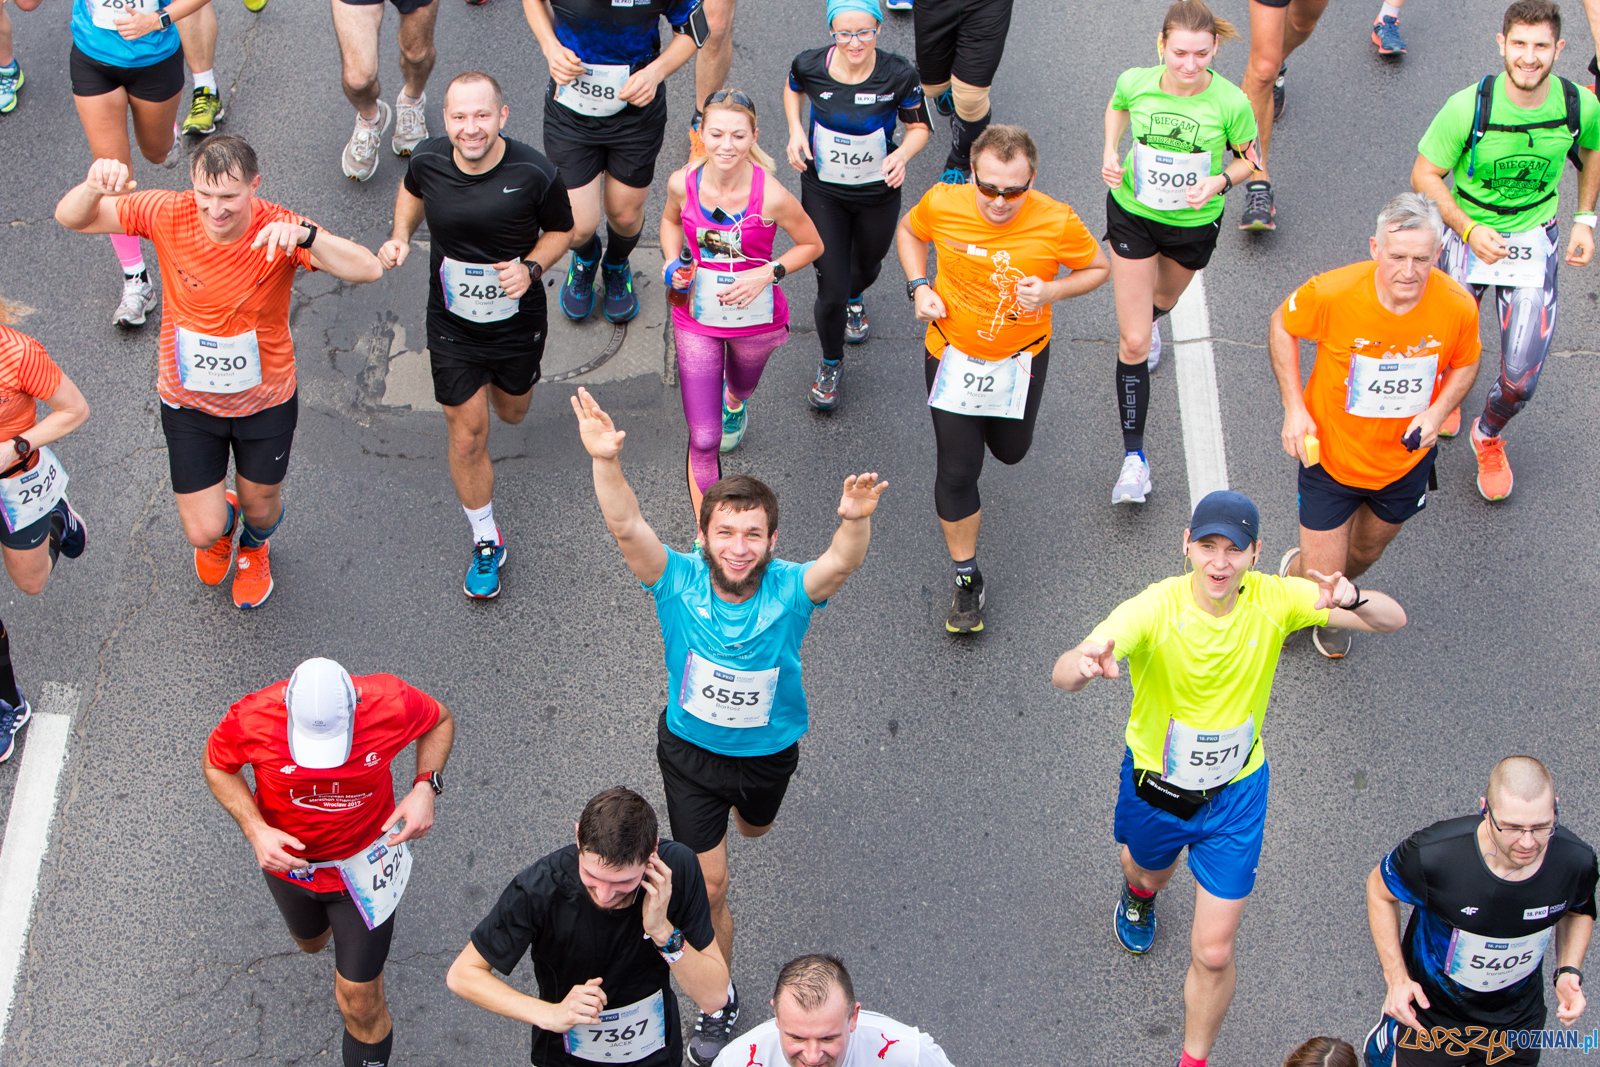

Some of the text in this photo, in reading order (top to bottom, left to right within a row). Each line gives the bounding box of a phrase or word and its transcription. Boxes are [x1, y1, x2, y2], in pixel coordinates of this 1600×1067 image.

[571, 79, 615, 99] 2588
[1154, 116, 1196, 133] BIEGAM
[830, 150, 874, 165] 2164
[1498, 160, 1546, 171] BIEGAM
[1148, 169, 1198, 188] 3908
[967, 244, 988, 257] Man
[1498, 245, 1532, 260] 83
[193, 353, 247, 372] 2930
[963, 372, 995, 392] 912
[1367, 378, 1423, 394] 4583
[18, 464, 57, 505] 2928
[702, 684, 760, 706] 6553
[715, 703, 741, 711] Bartosz
[1189, 744, 1240, 766] 5571
[280, 765, 297, 774] 4F
[373, 843, 404, 891] 4920
[1460, 906, 1479, 916] 4F
[1470, 950, 1534, 971] 5405
[588, 1018, 649, 1042] 7367
[609, 1040, 633, 1048] JACEK
